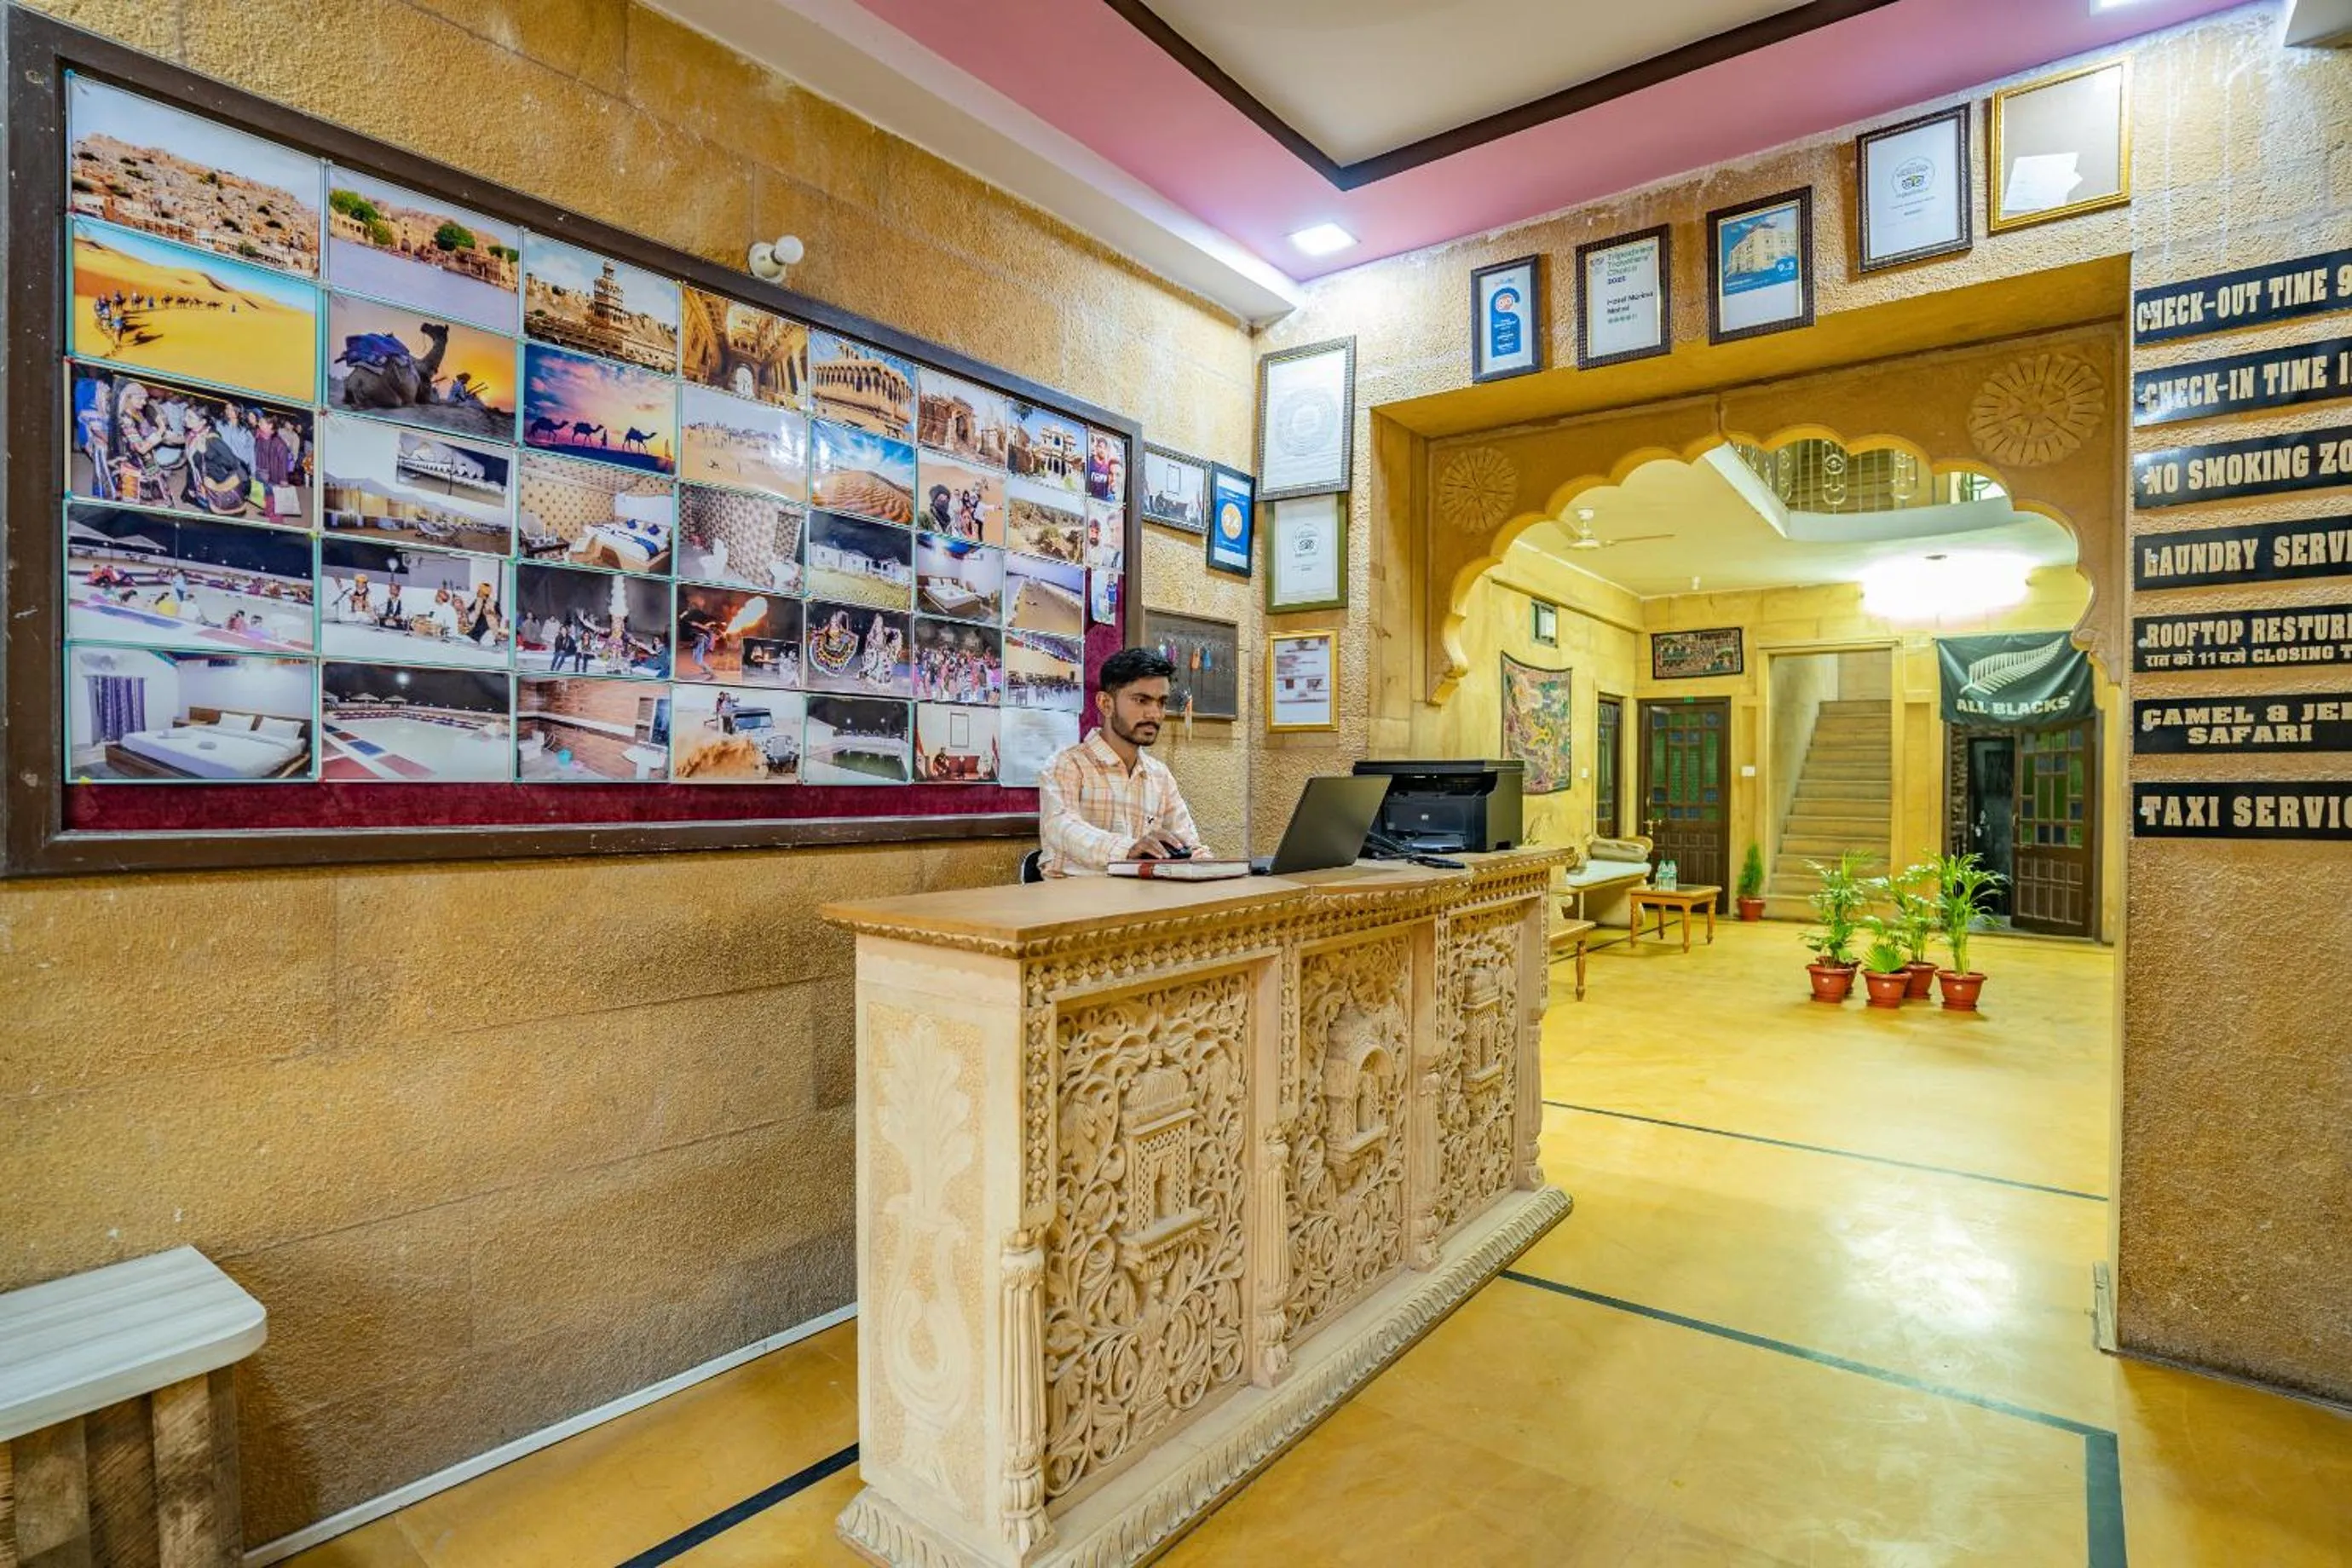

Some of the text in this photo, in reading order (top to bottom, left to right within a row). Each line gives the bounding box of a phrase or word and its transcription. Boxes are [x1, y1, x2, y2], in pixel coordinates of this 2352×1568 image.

[2136, 280, 2261, 333] CHECK-OUT
[2268, 268, 2327, 309] TIME
[2143, 366, 2255, 414] CHECK-IN
[2263, 355, 2327, 396] TIME
[2146, 463, 2179, 494] NO
[2188, 444, 2309, 490] SMOKING
[2144, 538, 2258, 578] LAUNDRY
[2146, 613, 2352, 648] ROOFTOP RESTUR
[2198, 652, 2217, 666] 11
[2251, 644, 2335, 663] CLOSING
[1956, 695, 2071, 716] ALL BLACKS
[2142, 706, 2254, 726] CAMEL
[2266, 705, 2288, 723] &
[2188, 724, 2314, 745] SAFARI
[2141, 796, 2220, 827] TAXI
